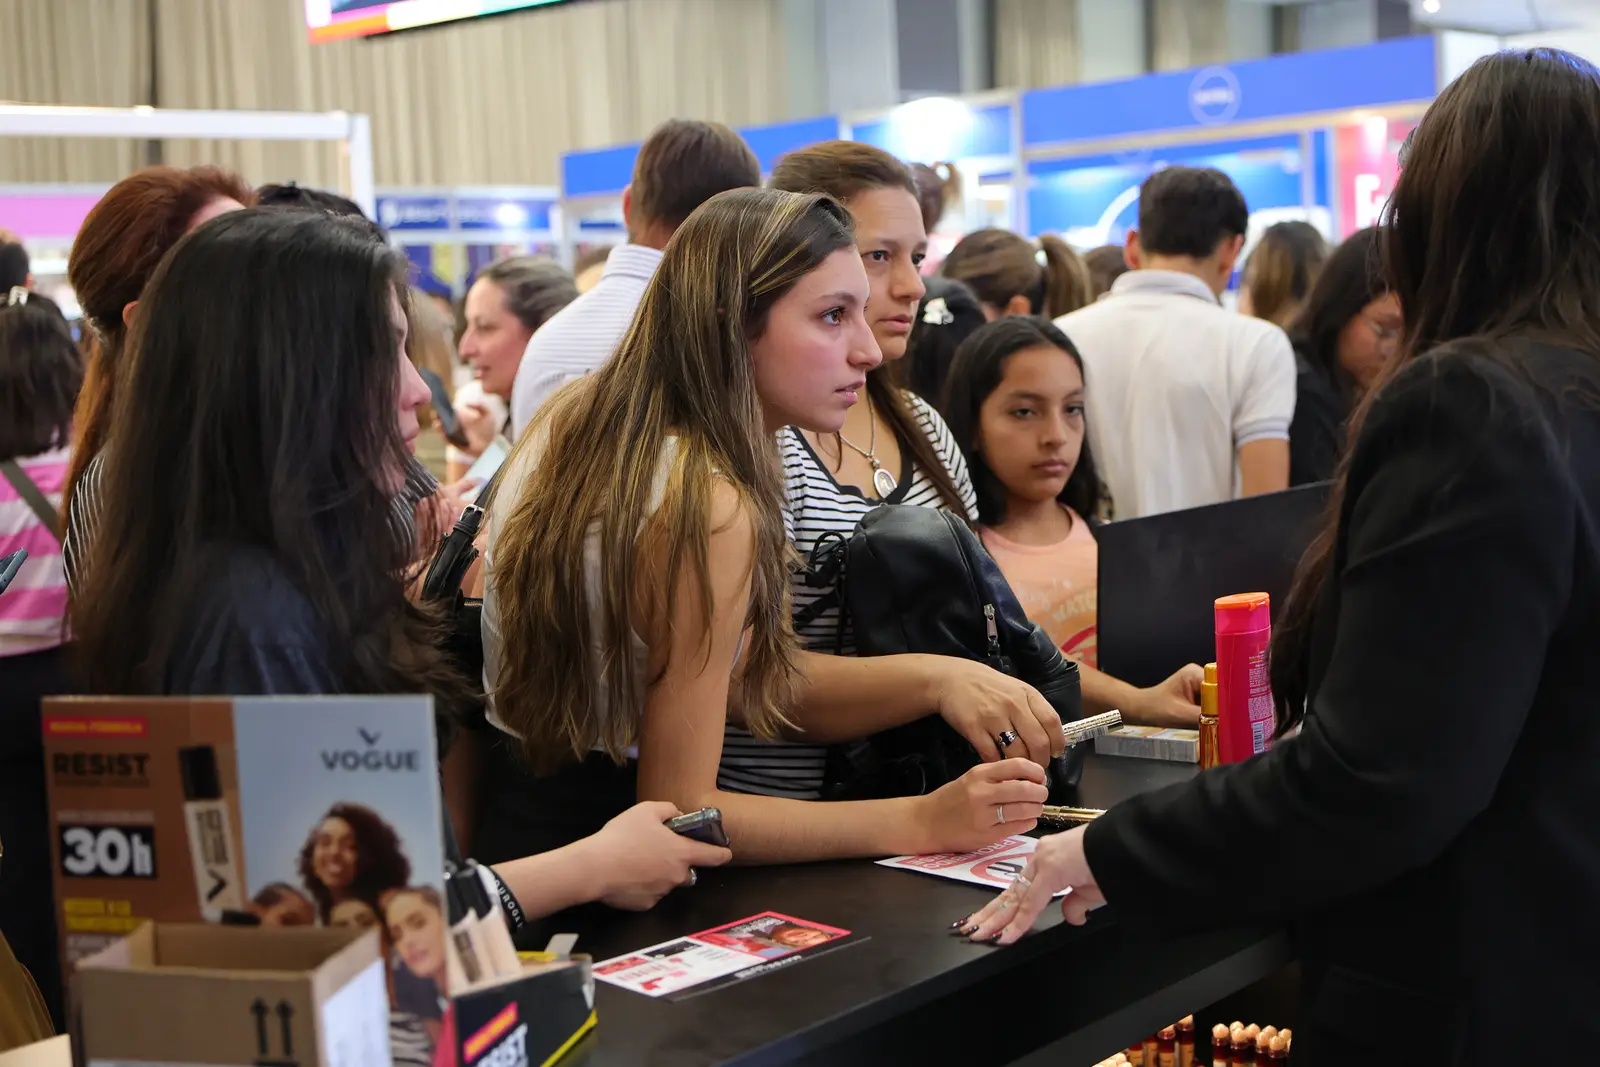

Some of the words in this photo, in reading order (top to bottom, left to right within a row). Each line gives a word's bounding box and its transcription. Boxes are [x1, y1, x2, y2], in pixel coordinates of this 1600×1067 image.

[52, 753, 149, 777] RESIST
[320, 750, 421, 771] VOGUE
[63, 827, 153, 876] 30h
